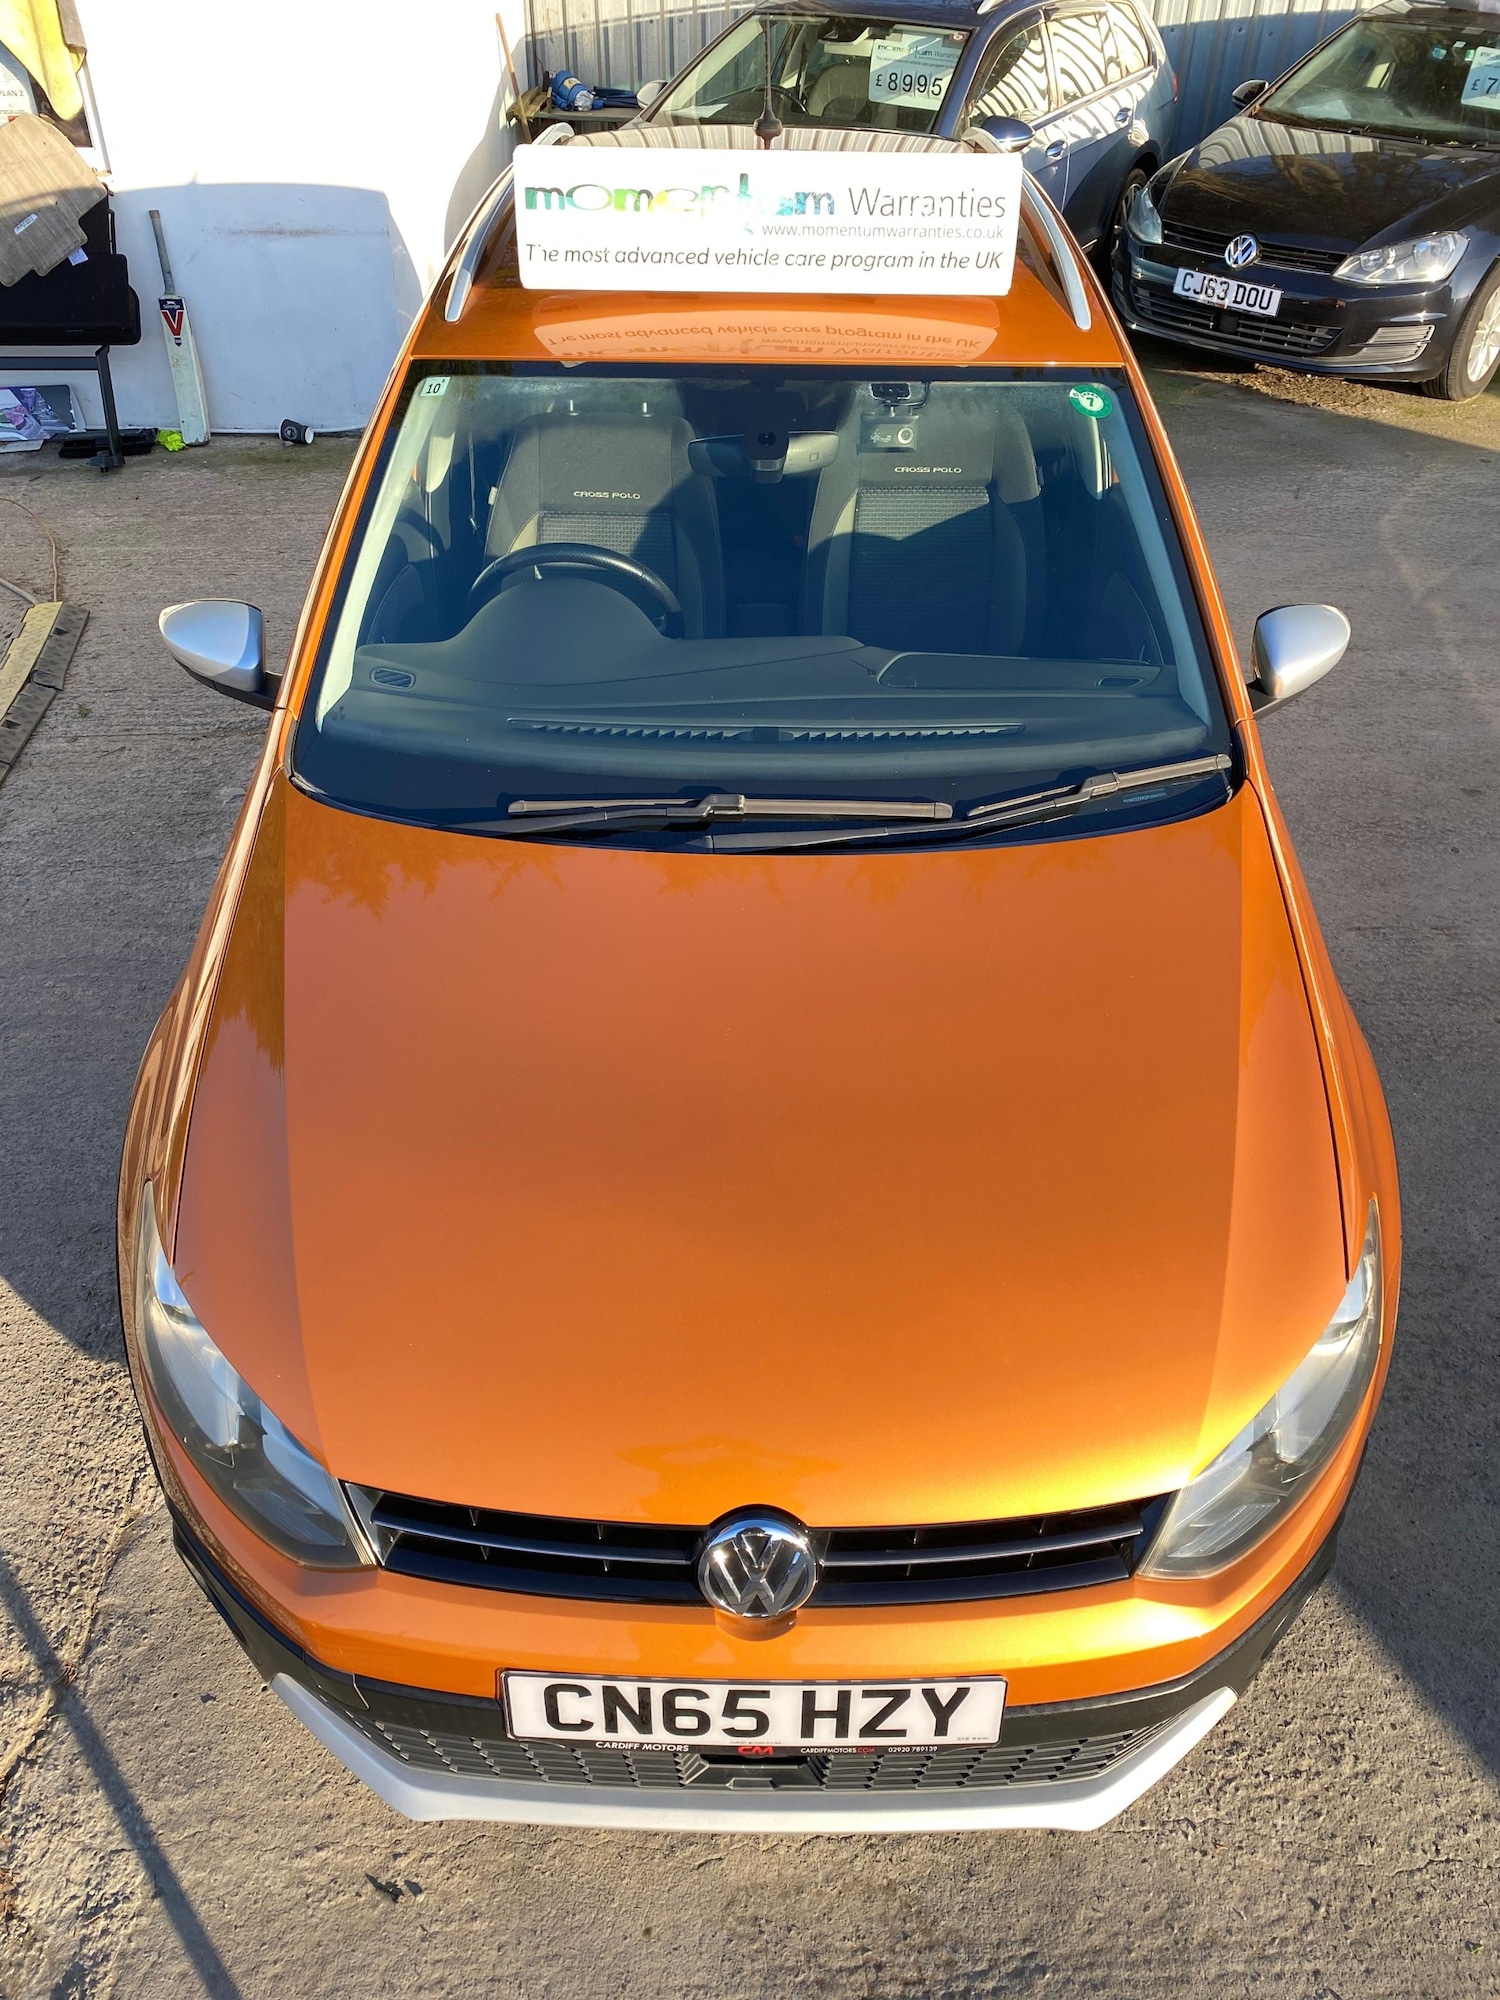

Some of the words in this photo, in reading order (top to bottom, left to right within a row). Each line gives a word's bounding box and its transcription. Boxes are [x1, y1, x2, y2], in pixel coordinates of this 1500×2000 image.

[848, 187, 1006, 218] Warranties
[762, 224, 1004, 239] www.momentumwarranties.co.uk
[564, 246, 610, 263] most
[615, 246, 710, 265] advanced
[714, 248, 779, 266] vehicle
[784, 253, 826, 267] care
[831, 253, 914, 271] program
[918, 251, 935, 268] in
[940, 252, 970, 269] the
[975, 252, 1003, 269] UK
[1181, 272, 1230, 301] CJ63
[1232, 283, 1273, 311] DOU
[573, 490, 610, 499] CROSS
[611, 492, 641, 500] POLO
[543, 1683, 771, 1738] CN65
[800, 1687, 971, 1739] HZY
[595, 1741, 640, 1750] CARDIFF
[643, 1743, 690, 1752] MOTORS
[911, 1745, 938, 1753] 789139
